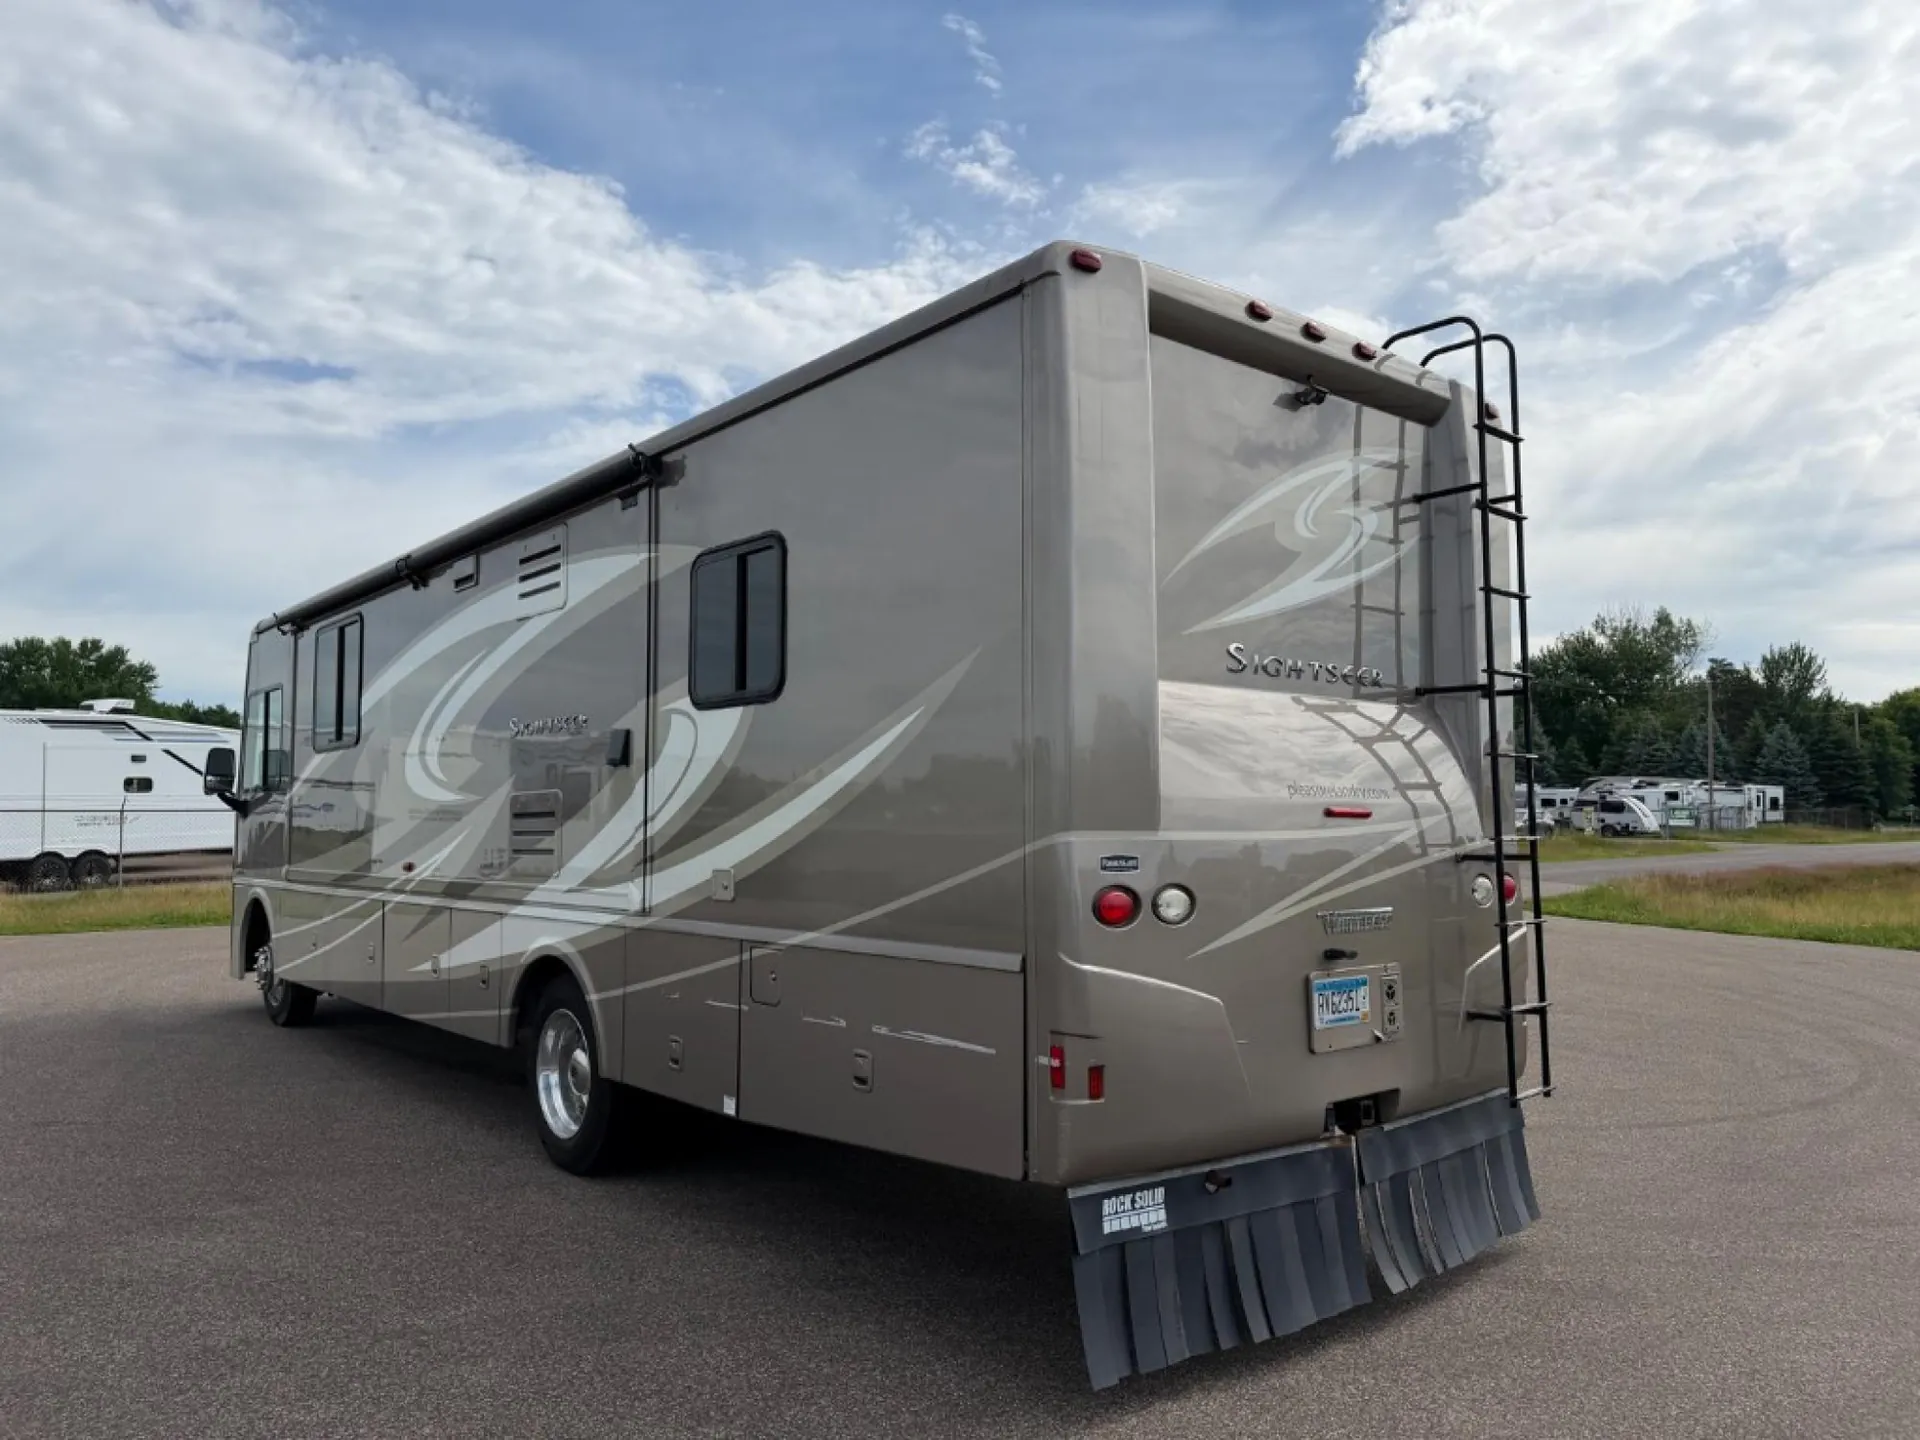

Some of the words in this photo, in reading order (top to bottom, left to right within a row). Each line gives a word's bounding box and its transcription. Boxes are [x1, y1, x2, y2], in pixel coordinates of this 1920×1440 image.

[1226, 642, 1384, 688] SIGHTSEER
[1102, 1193, 1133, 1216] ROCK
[1134, 1186, 1165, 1208] SOLID
